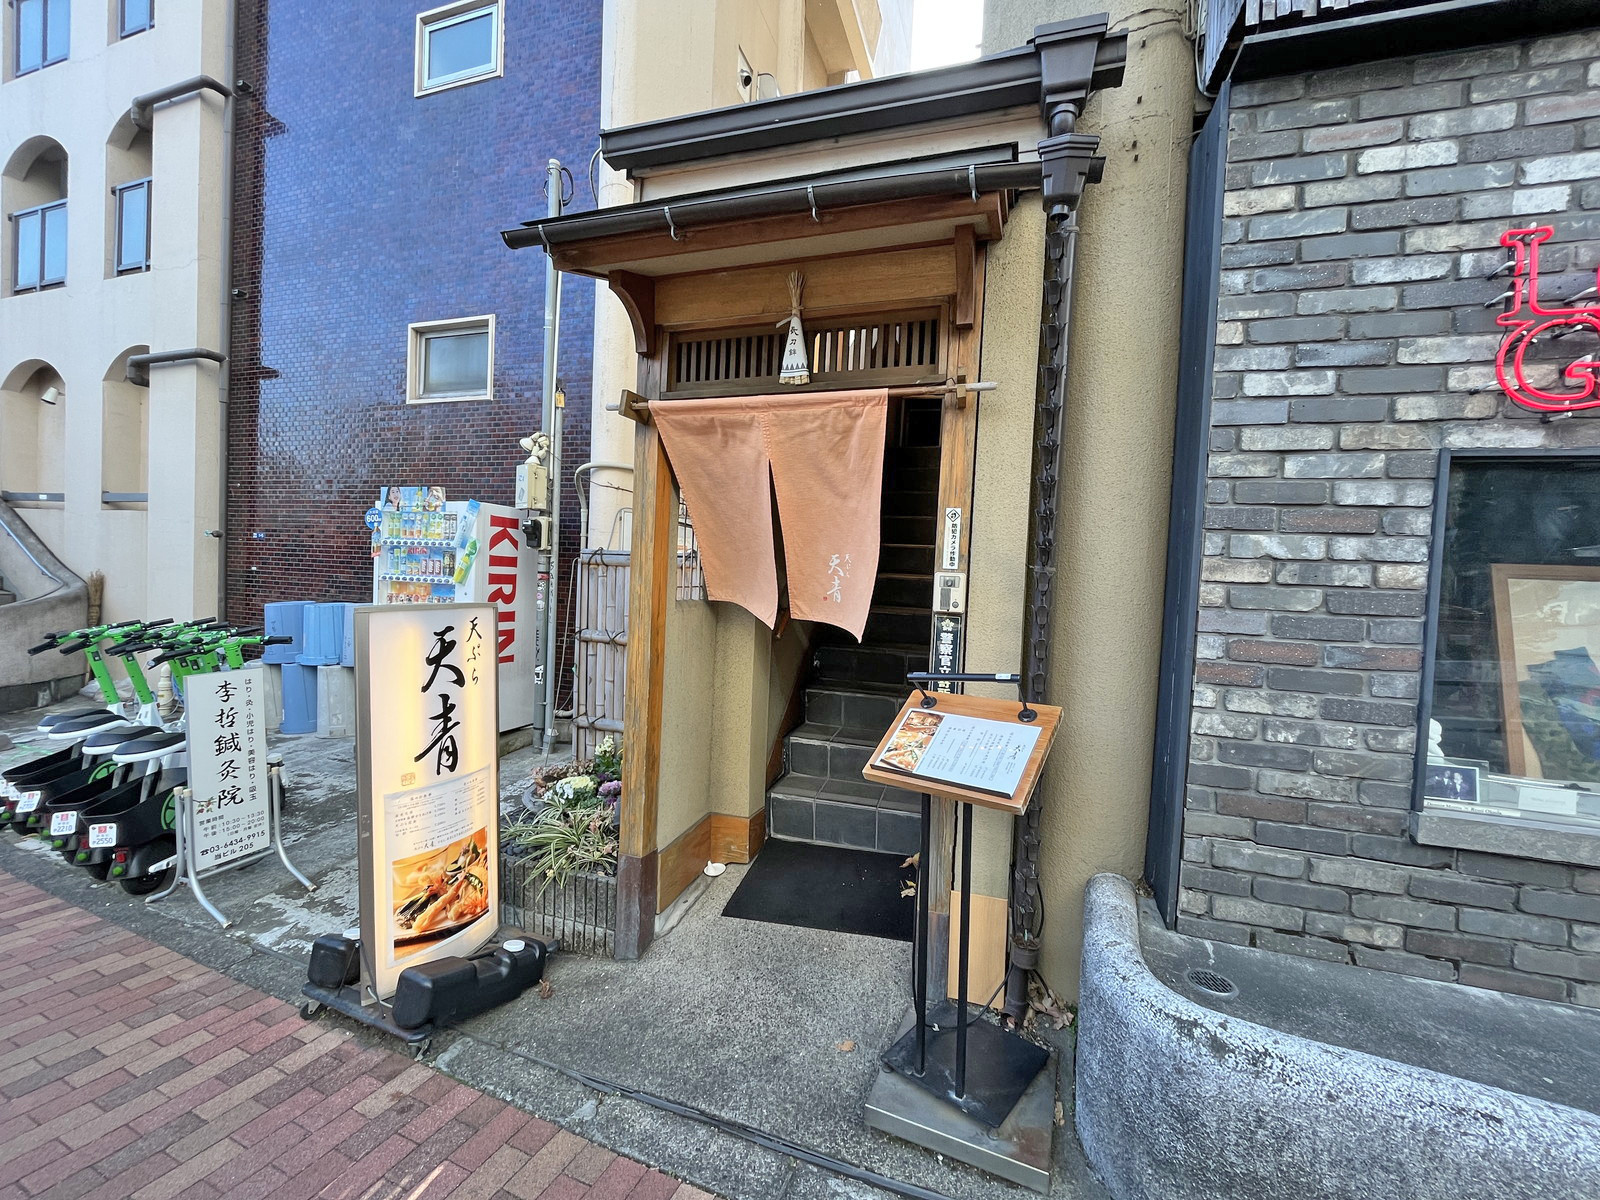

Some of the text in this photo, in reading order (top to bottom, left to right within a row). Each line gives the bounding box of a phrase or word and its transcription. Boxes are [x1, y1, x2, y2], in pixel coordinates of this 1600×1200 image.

[489, 514, 519, 664] KIRIN
[826, 553, 845, 604] 天青
[414, 625, 467, 776] 天青
[465, 615, 483, 686] 天ぷら
[213, 680, 244, 809] 李哲鍼灸院
[239, 842, 254, 852] 205
